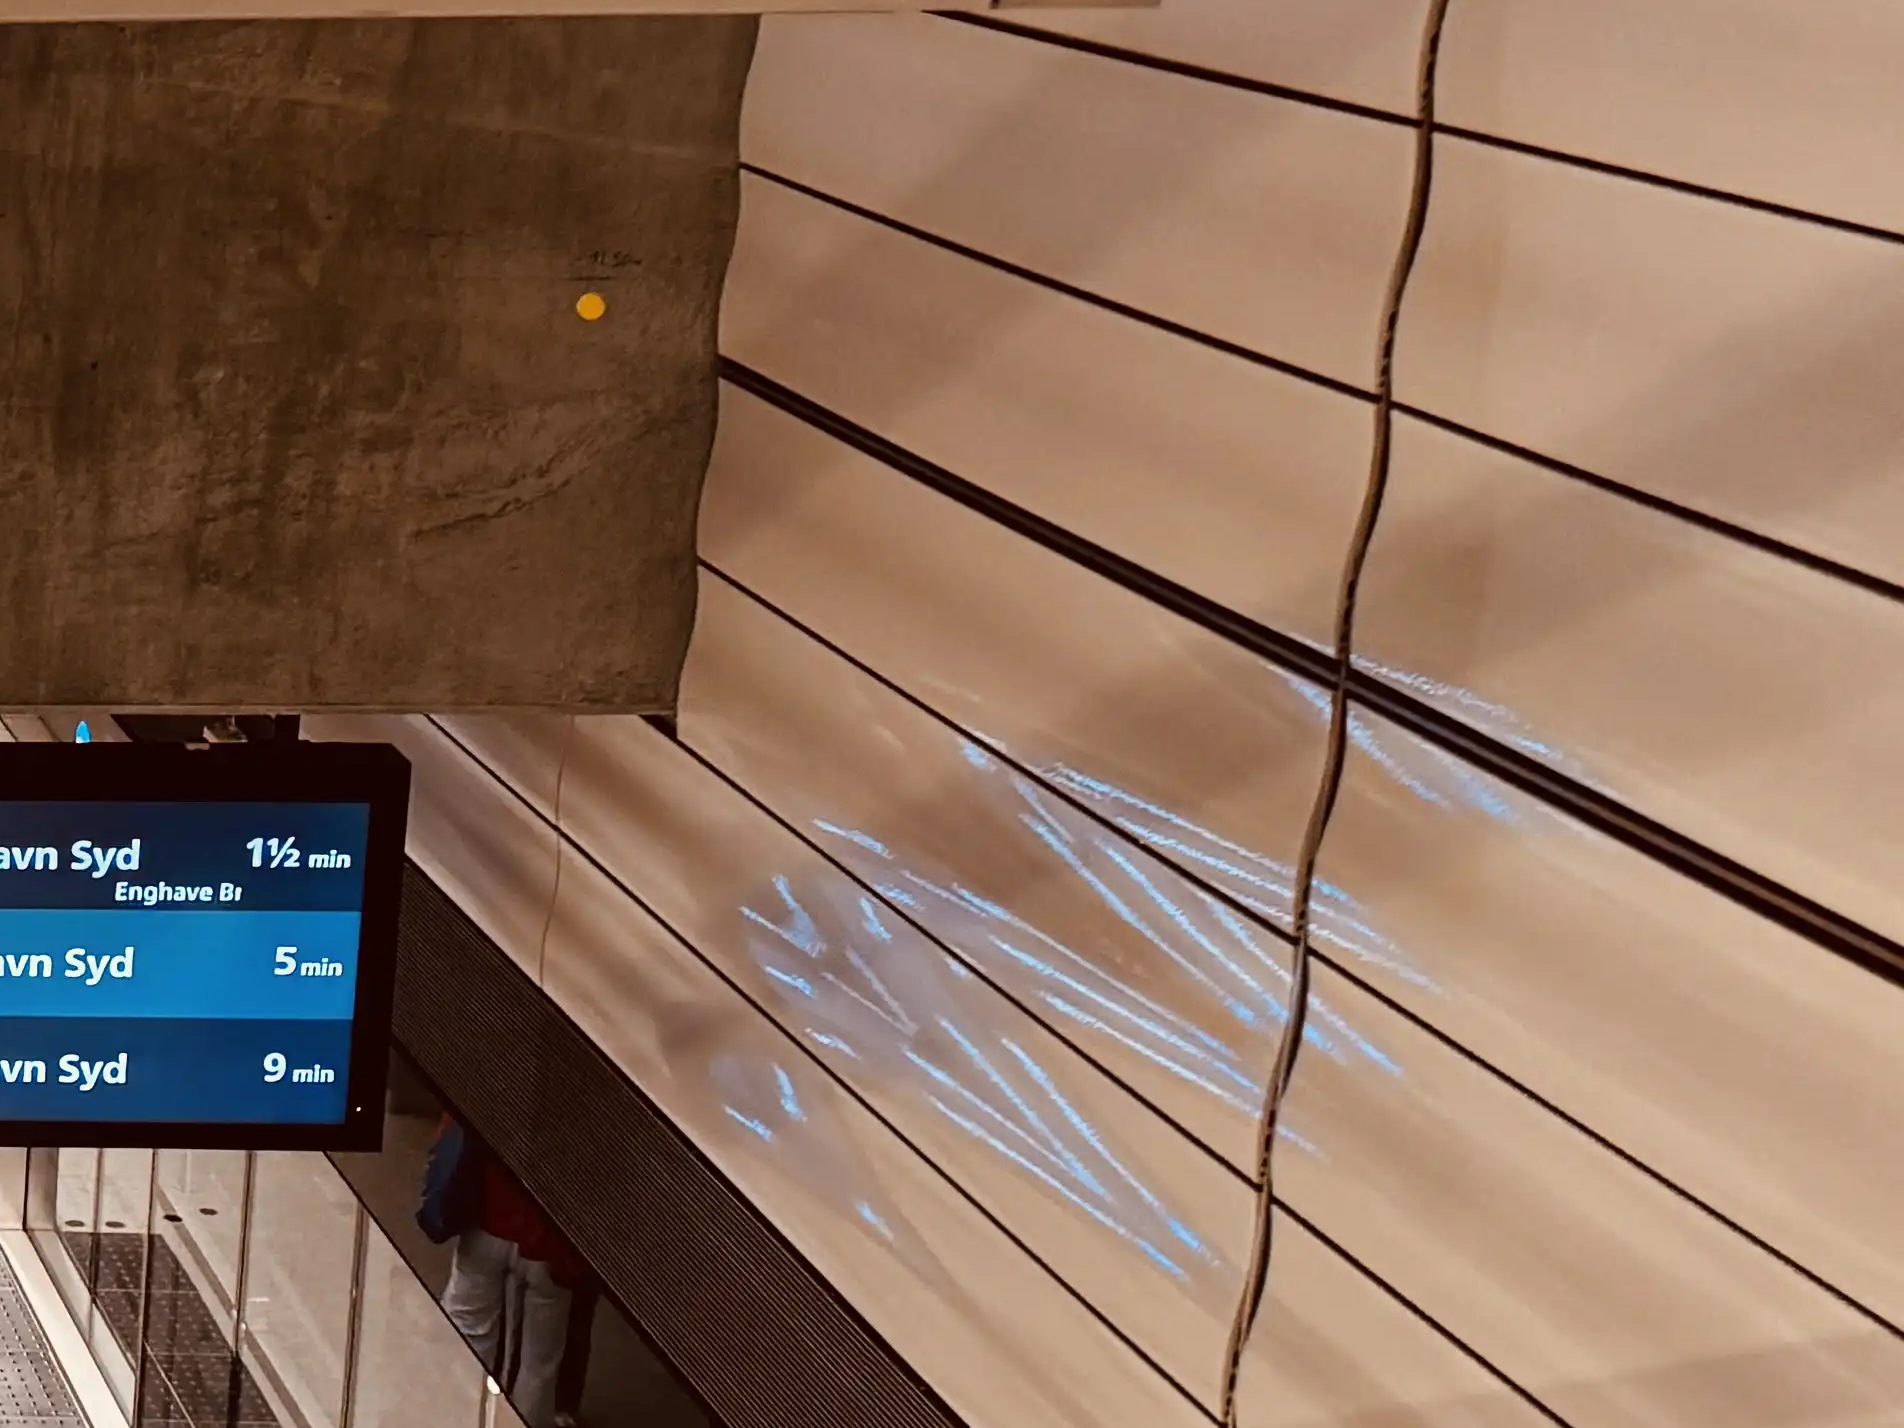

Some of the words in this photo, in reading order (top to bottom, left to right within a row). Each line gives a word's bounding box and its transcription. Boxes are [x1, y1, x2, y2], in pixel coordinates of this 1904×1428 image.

[70, 838, 141, 879] Syd
[308, 849, 352, 869] min
[114, 881, 214, 906] Enghave
[64, 946, 135, 986] Syd
[274, 946, 297, 977] 5
[300, 956, 343, 977] min
[58, 1052, 128, 1092] Syd
[263, 1052, 287, 1083] 9
[292, 1062, 335, 1083] min
